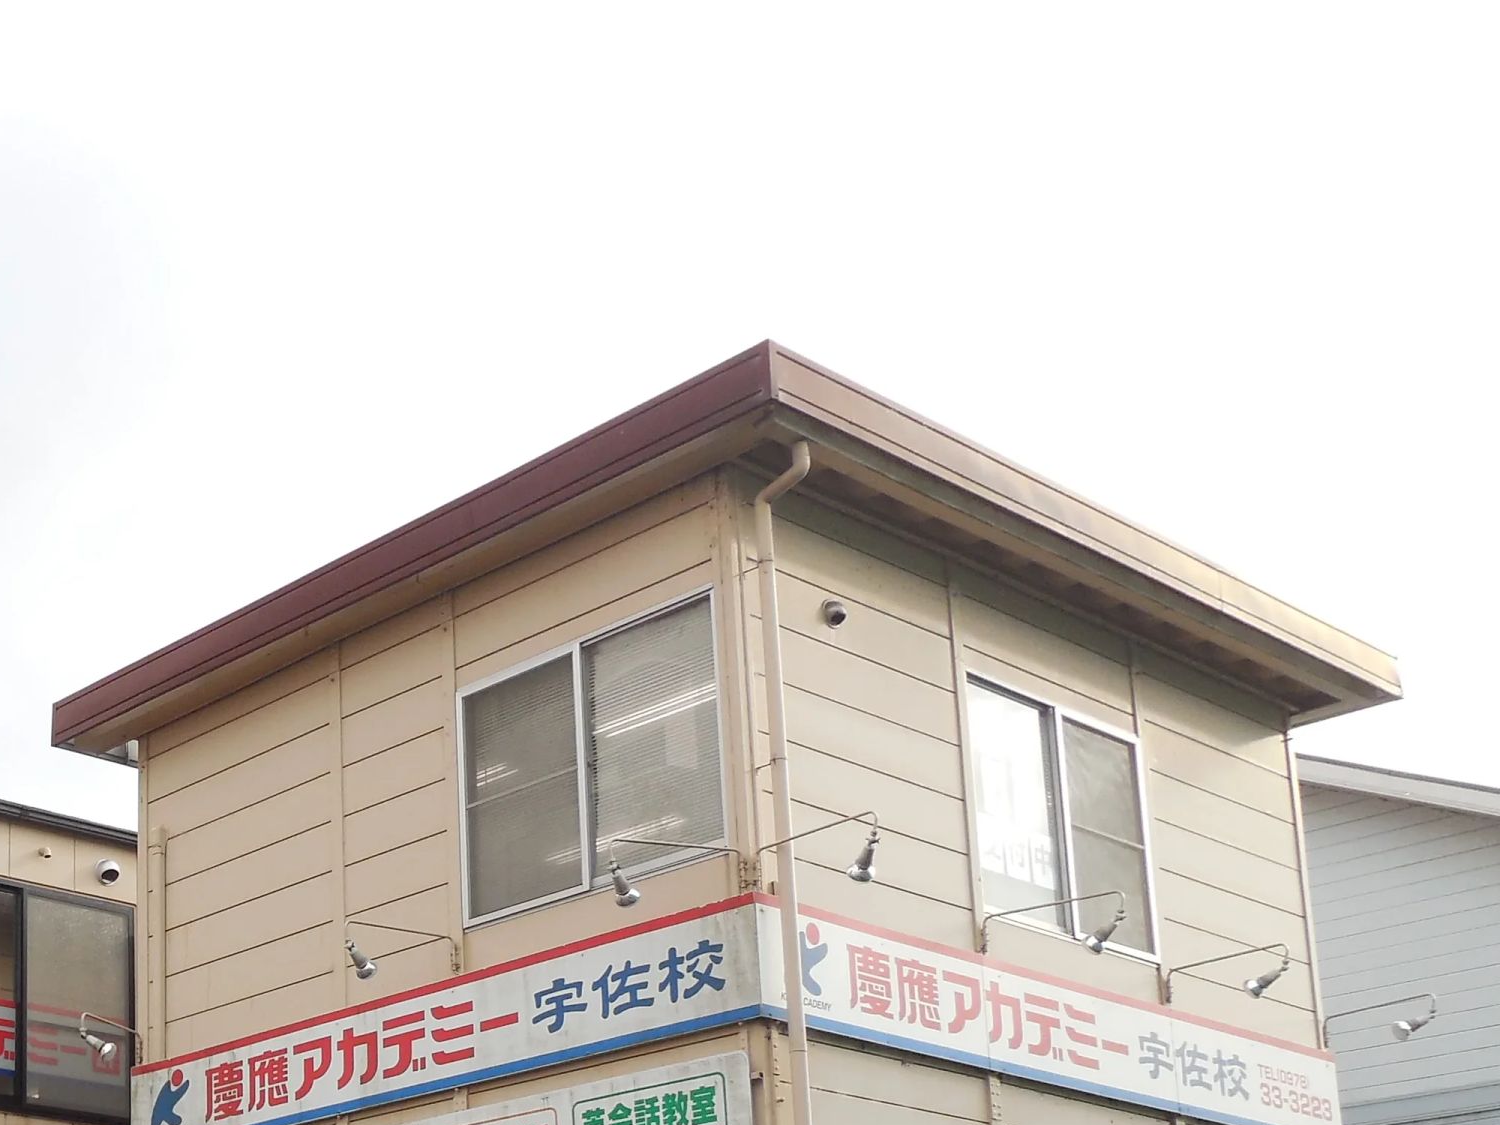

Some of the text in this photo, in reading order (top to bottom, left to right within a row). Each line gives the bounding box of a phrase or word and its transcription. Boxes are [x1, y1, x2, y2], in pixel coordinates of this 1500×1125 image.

[204, 938, 727, 1123] 慶應アカデミー 宇佐校
[803, 996, 832, 1011] CADEMY
[846, 942, 1250, 1101] 慶應アカデミー 宇佐校
[1260, 1082, 1333, 1122] 33-3223
